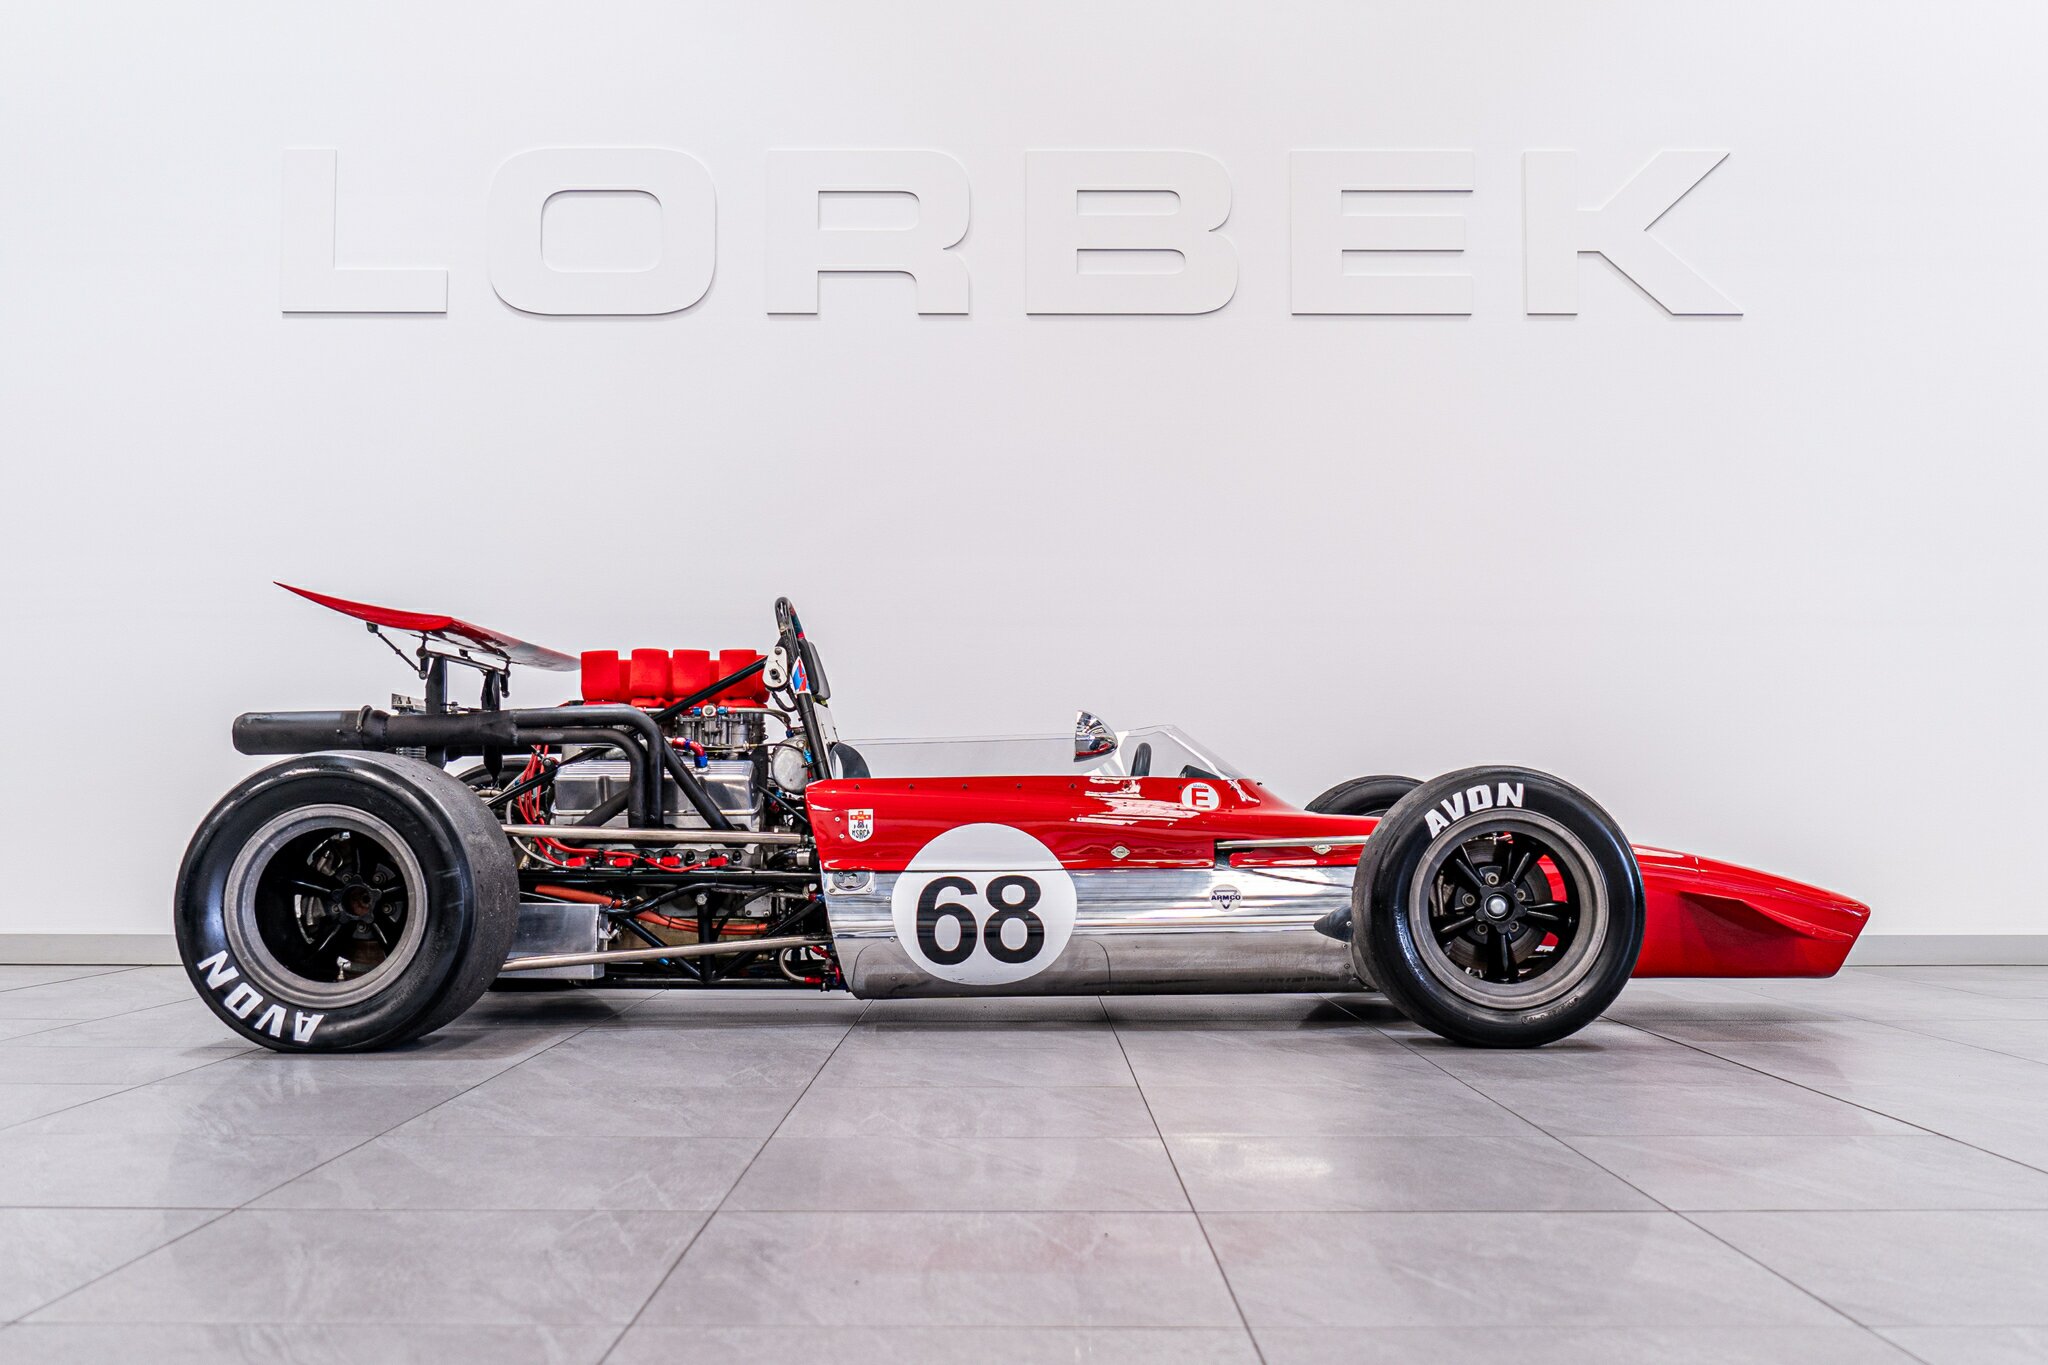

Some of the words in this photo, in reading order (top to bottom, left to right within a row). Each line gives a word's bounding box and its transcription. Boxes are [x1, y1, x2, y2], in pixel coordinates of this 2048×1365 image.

[281, 147, 1743, 316] LORBEK
[1191, 787, 1210, 808] E
[1424, 782, 1524, 839] AVON
[916, 875, 1044, 965] 68
[197, 950, 325, 1043] AVON
